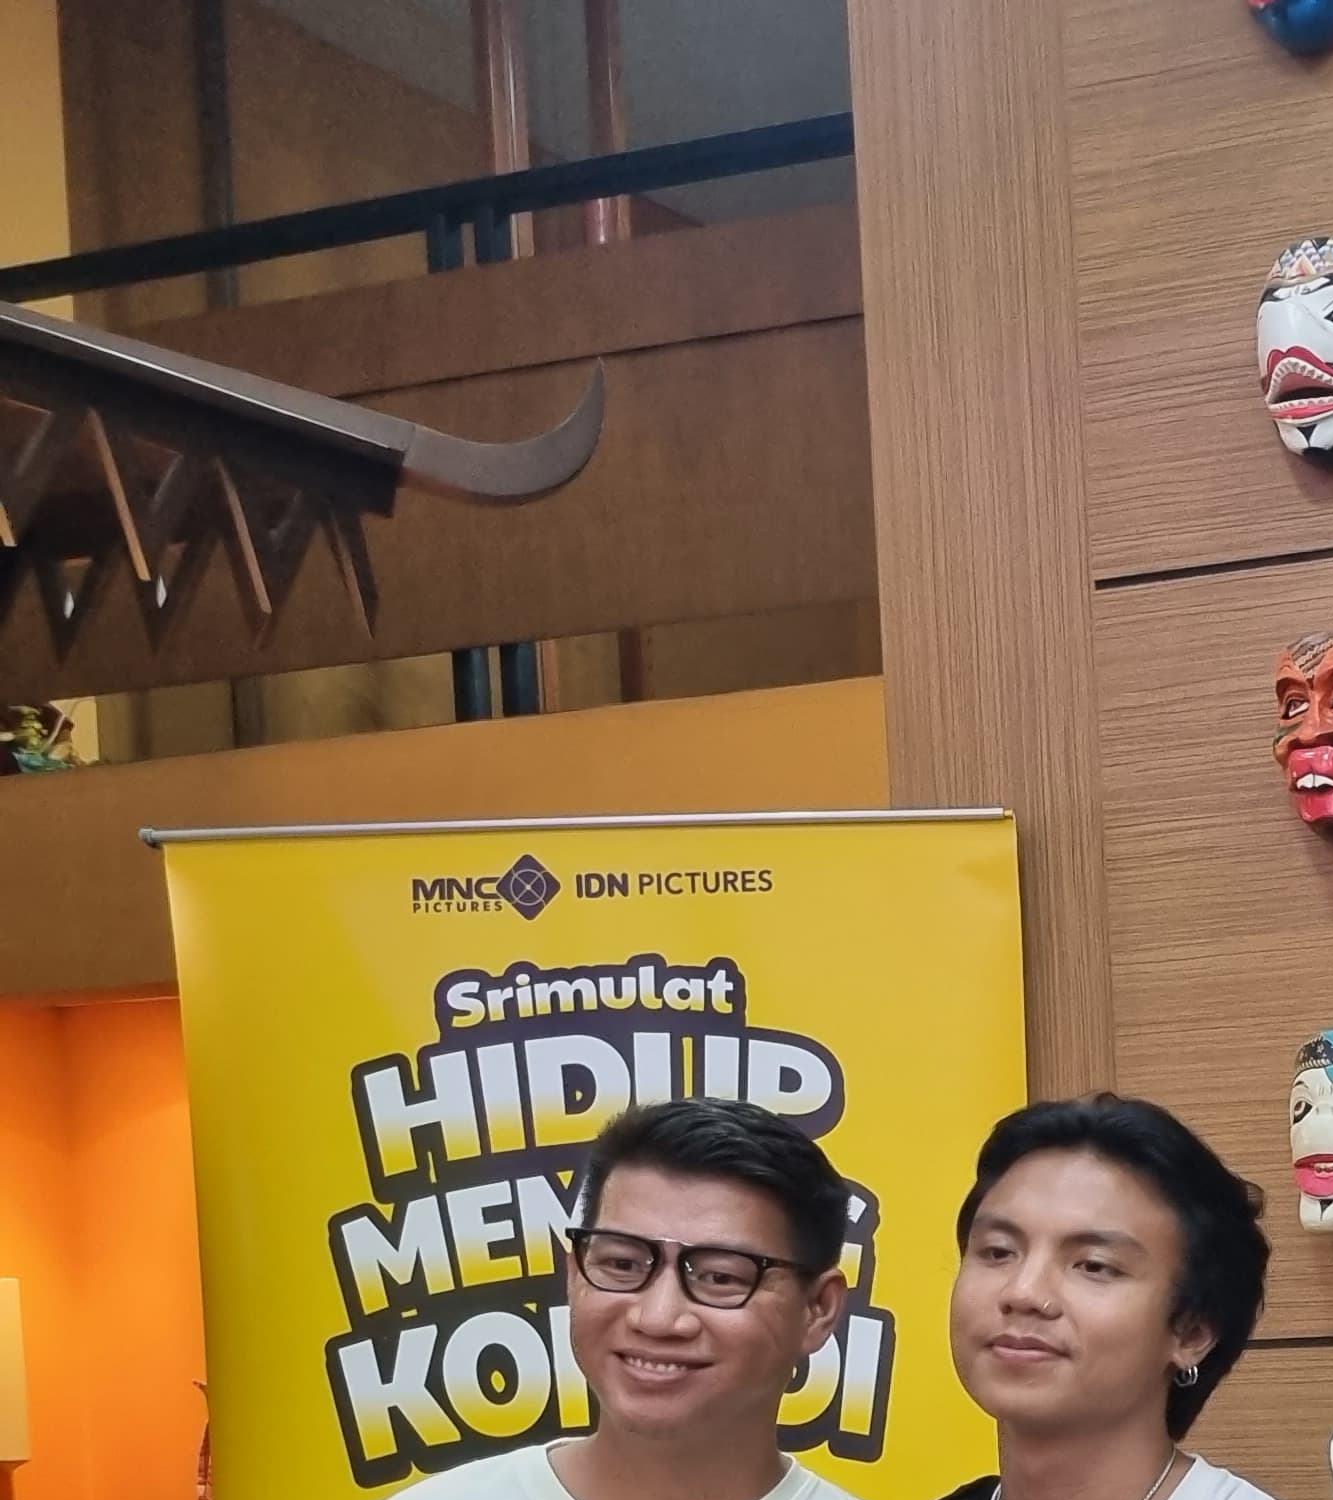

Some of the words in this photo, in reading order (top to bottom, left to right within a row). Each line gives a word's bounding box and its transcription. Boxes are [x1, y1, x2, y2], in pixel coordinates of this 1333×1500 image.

[411, 876, 499, 901] MNC
[575, 872, 629, 899] IDN
[638, 869, 773, 896] PICTURES
[412, 901, 503, 914] PICTURES
[446, 965, 734, 1029] Srimulat
